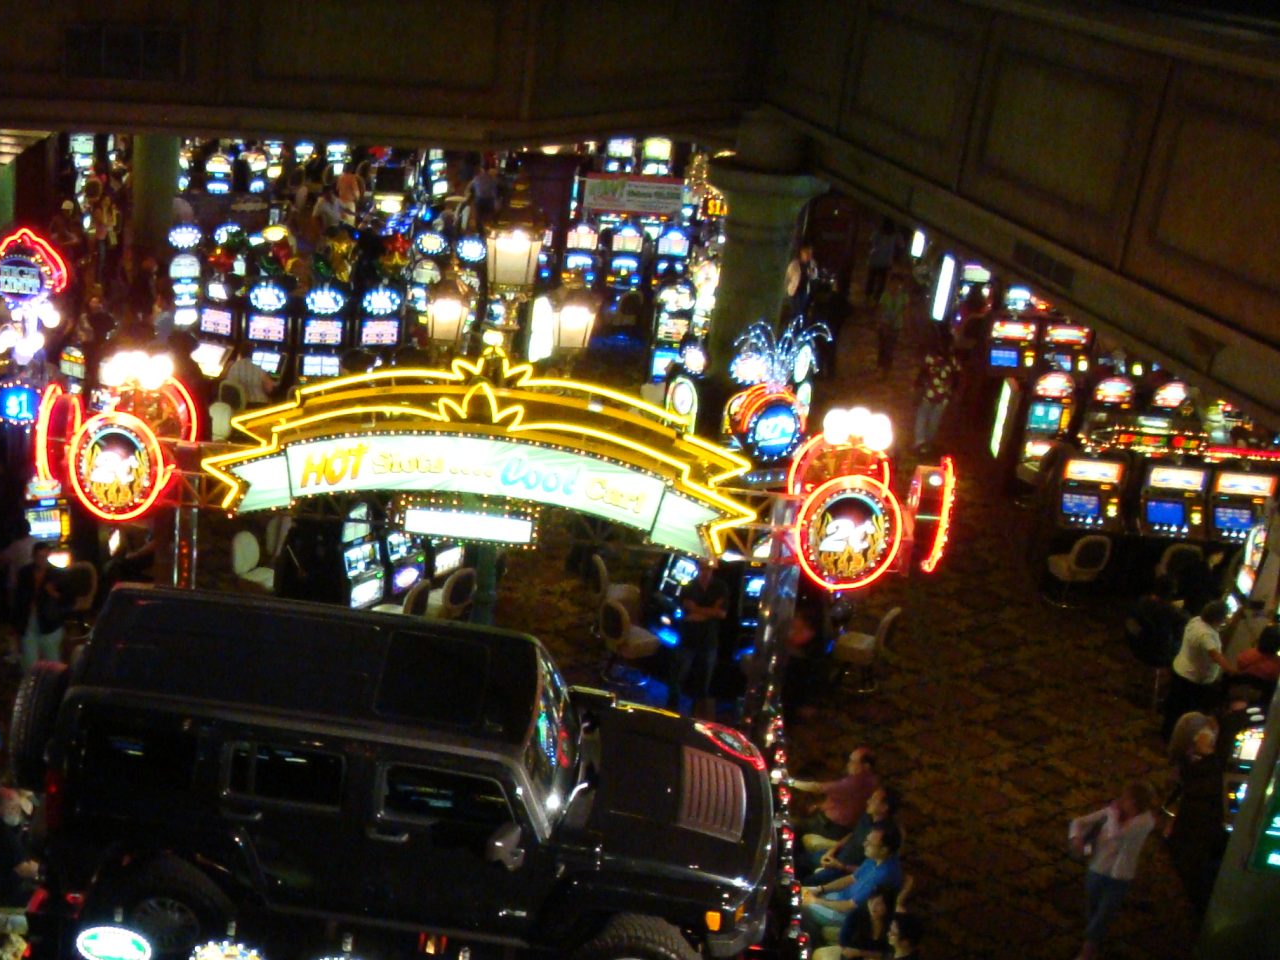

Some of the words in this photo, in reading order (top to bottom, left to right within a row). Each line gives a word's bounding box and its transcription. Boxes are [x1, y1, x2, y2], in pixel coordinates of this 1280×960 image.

[300, 443, 368, 489] HOT
[371, 452, 445, 475] Slots
[499, 454, 580, 496] Cool
